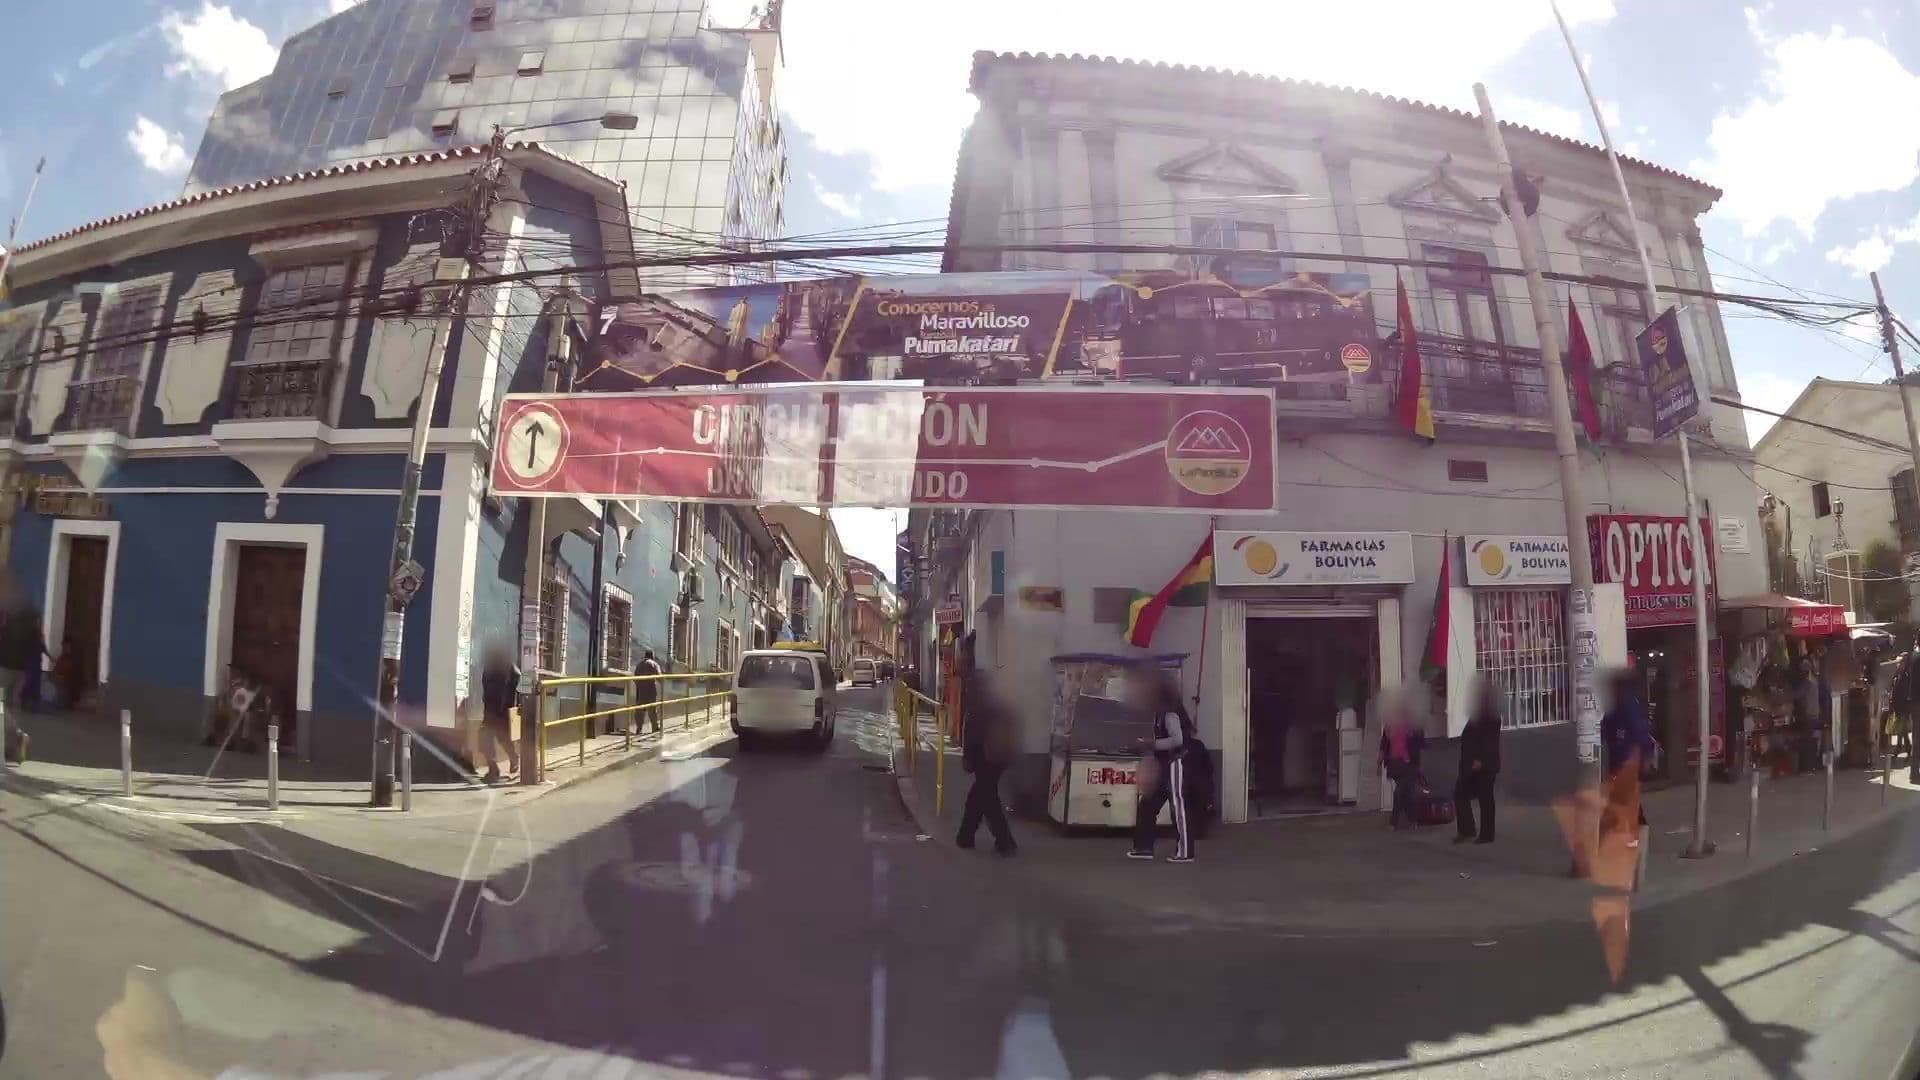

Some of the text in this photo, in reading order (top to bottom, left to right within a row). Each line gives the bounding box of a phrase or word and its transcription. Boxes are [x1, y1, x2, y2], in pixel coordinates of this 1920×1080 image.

[920, 311, 1030, 330] Maravilloso
[904, 334, 1020, 353] Pumakatari
[1301, 540, 1386, 552] FARMACIAS
[1315, 556, 1376, 568] BOLIVIA
[1521, 558, 1568, 568] BOLIVIA
